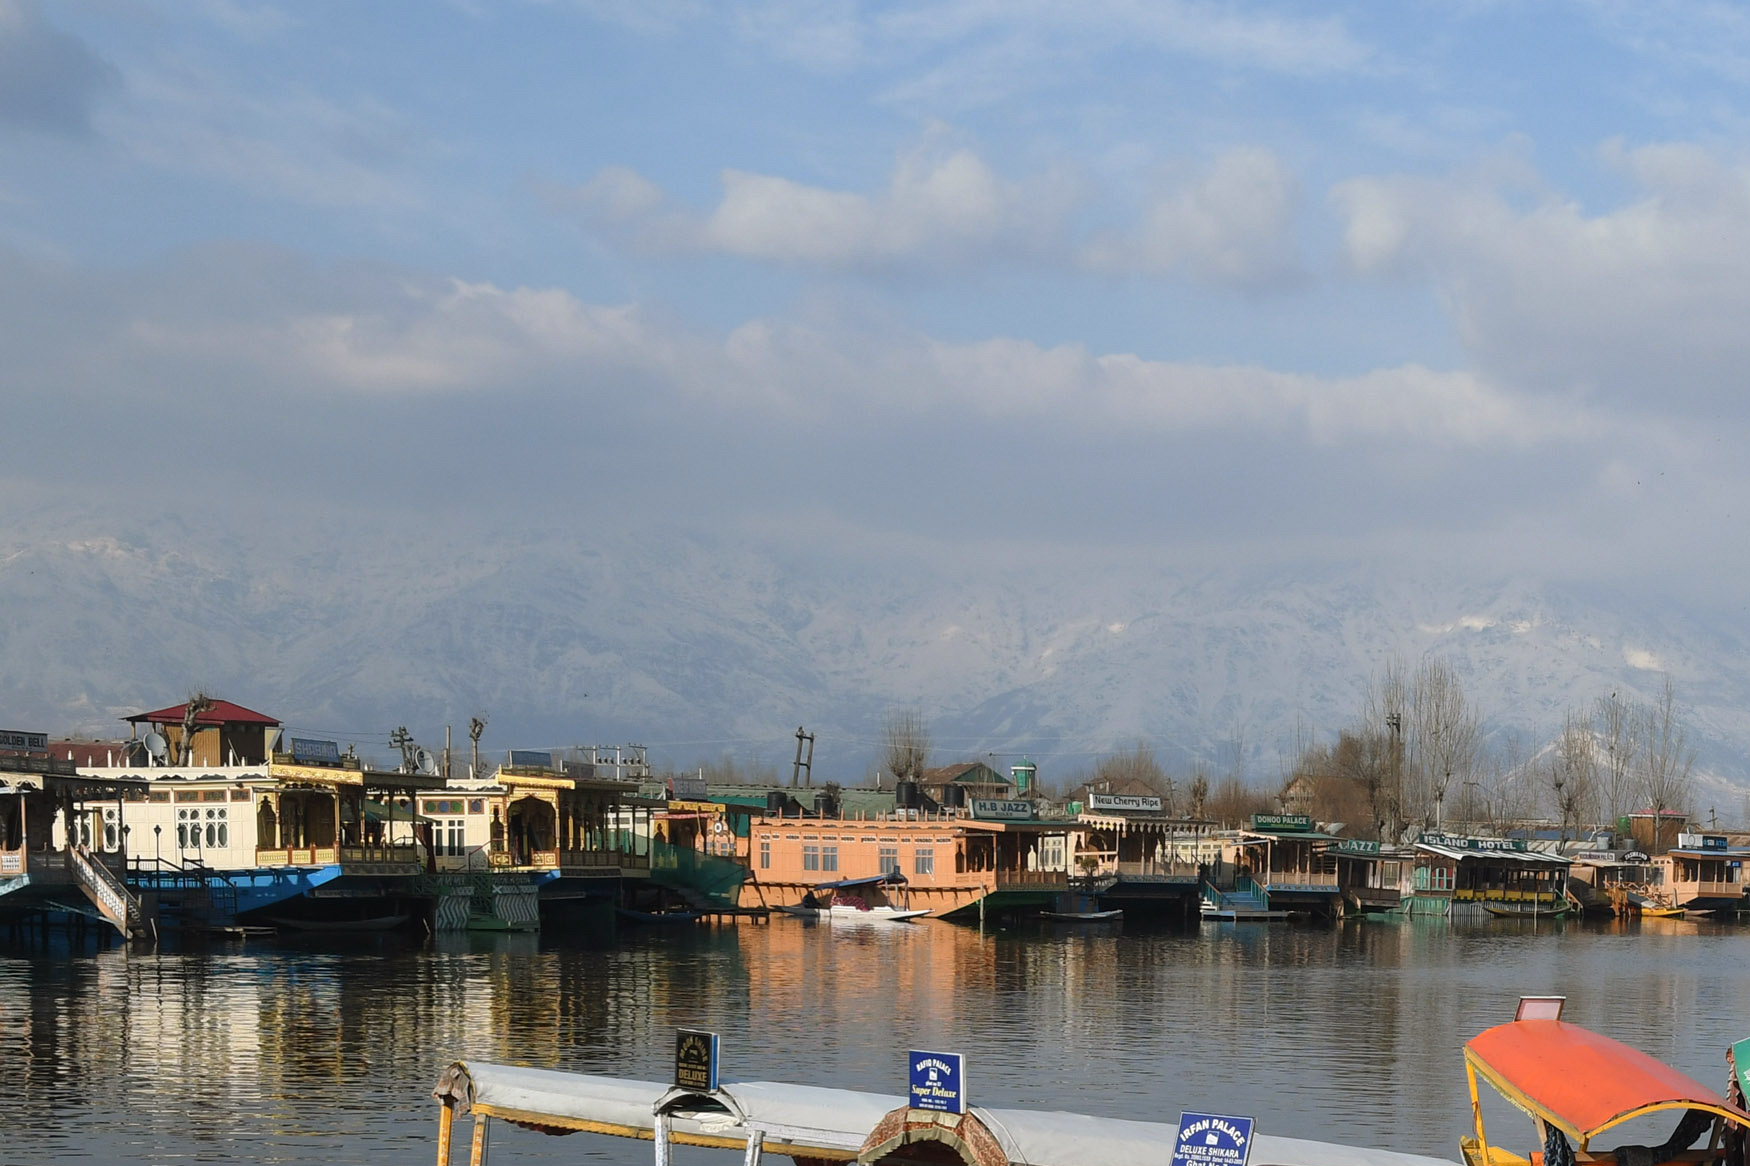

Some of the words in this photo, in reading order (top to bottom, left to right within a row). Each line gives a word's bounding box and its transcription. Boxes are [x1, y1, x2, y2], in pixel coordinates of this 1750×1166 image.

[28, 735, 45, 748] BELL
[979, 802, 998, 811] H.B
[1000, 803, 1028, 813] JAZZ
[1095, 796, 1112, 805] New
[1113, 797, 1140, 807] Cherry
[1141, 798, 1159, 808] Ripe
[1282, 816, 1307, 825] PALACE
[1423, 835, 1469, 848] ISLAND
[1478, 840, 1516, 850] HOTEL
[932, 1059, 952, 1076] PALACE
[678, 1069, 707, 1082] DELUXE
[911, 1084, 931, 1097] Super
[932, 1086, 957, 1099] Deluxe
[1180, 1119, 1210, 1142] IRFAN
[1211, 1118, 1246, 1147] PALACE
[1180, 1144, 1207, 1155] DELUXE
[1208, 1147, 1239, 1158] SHIKARA
